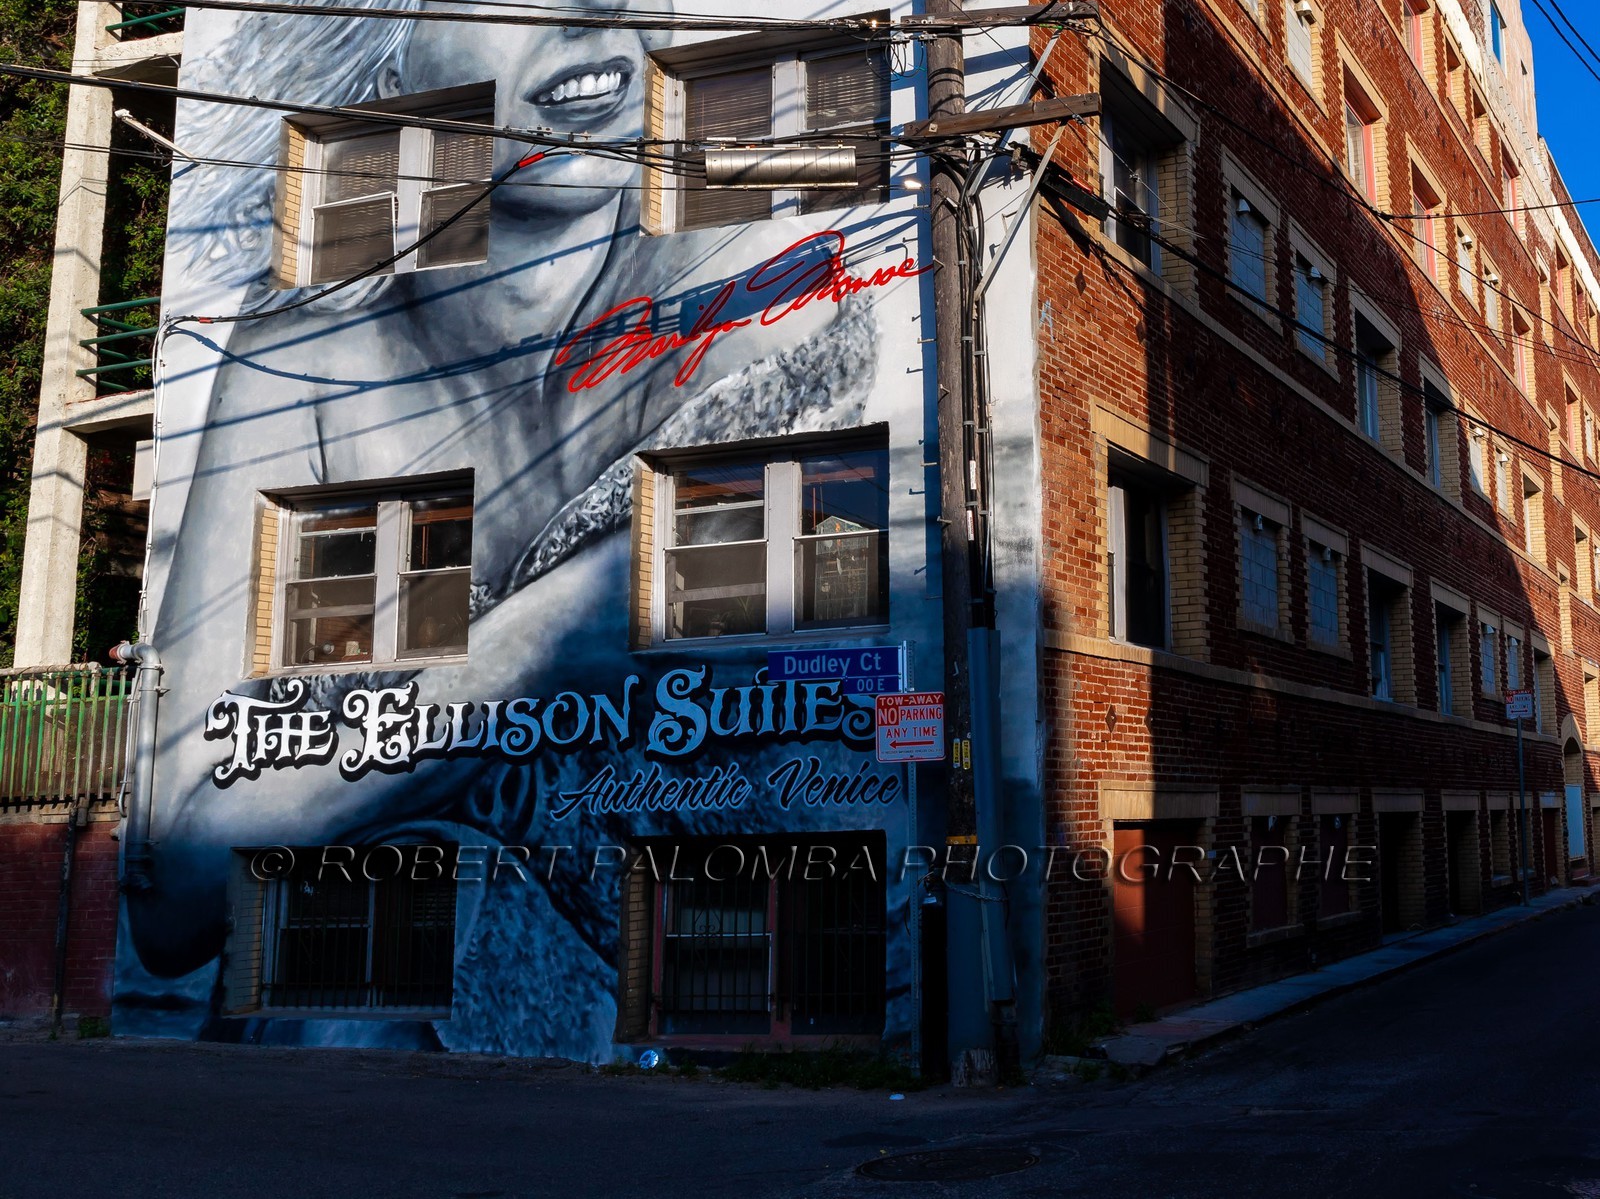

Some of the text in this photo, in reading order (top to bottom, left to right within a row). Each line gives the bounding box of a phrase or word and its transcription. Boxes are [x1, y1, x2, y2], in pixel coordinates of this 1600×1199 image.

[784, 652, 881, 676] Dudley Ct
[857, 678, 885, 692] 00 E
[879, 694, 942, 707] TOW-AWAY
[878, 707, 942, 725] NO PARKING
[886, 726, 938, 739] ANY TIME
[550, 756, 901, 822] Authentic Venice
